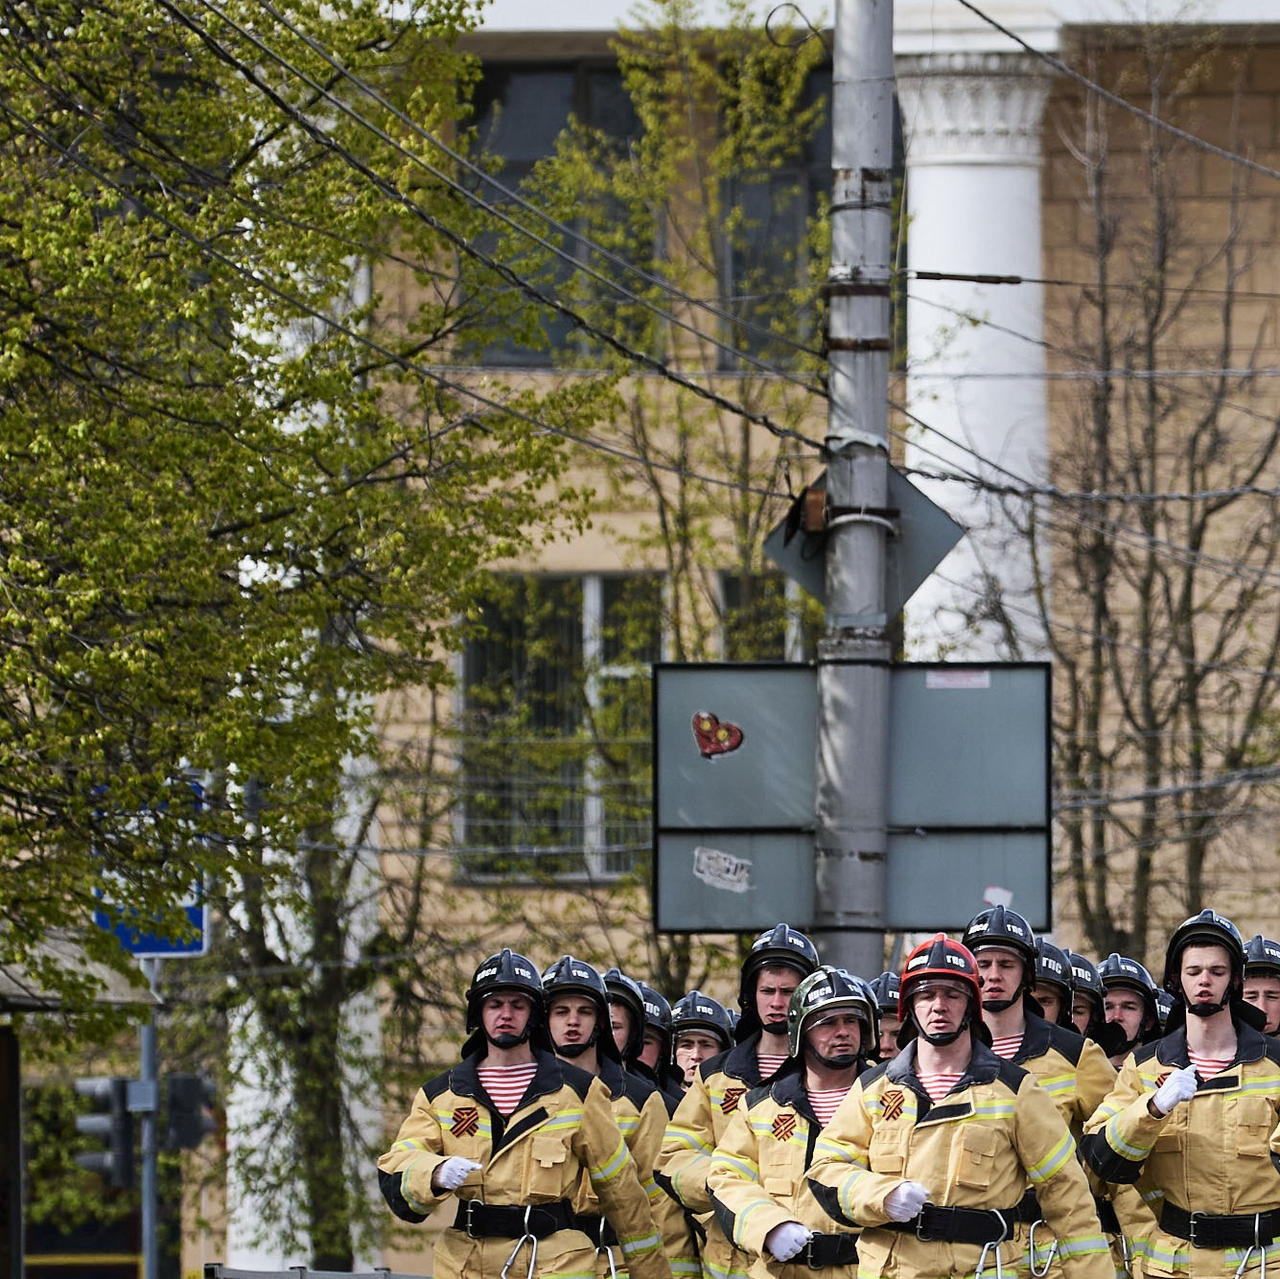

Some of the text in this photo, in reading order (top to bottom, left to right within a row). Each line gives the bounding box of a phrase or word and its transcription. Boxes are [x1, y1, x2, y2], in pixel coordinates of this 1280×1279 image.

[1006, 924, 1024, 936] ГПС
[945, 954, 966, 968] ГПС
[1042, 956, 1063, 974] ГПС
[1072, 966, 1092, 982] ГПС
